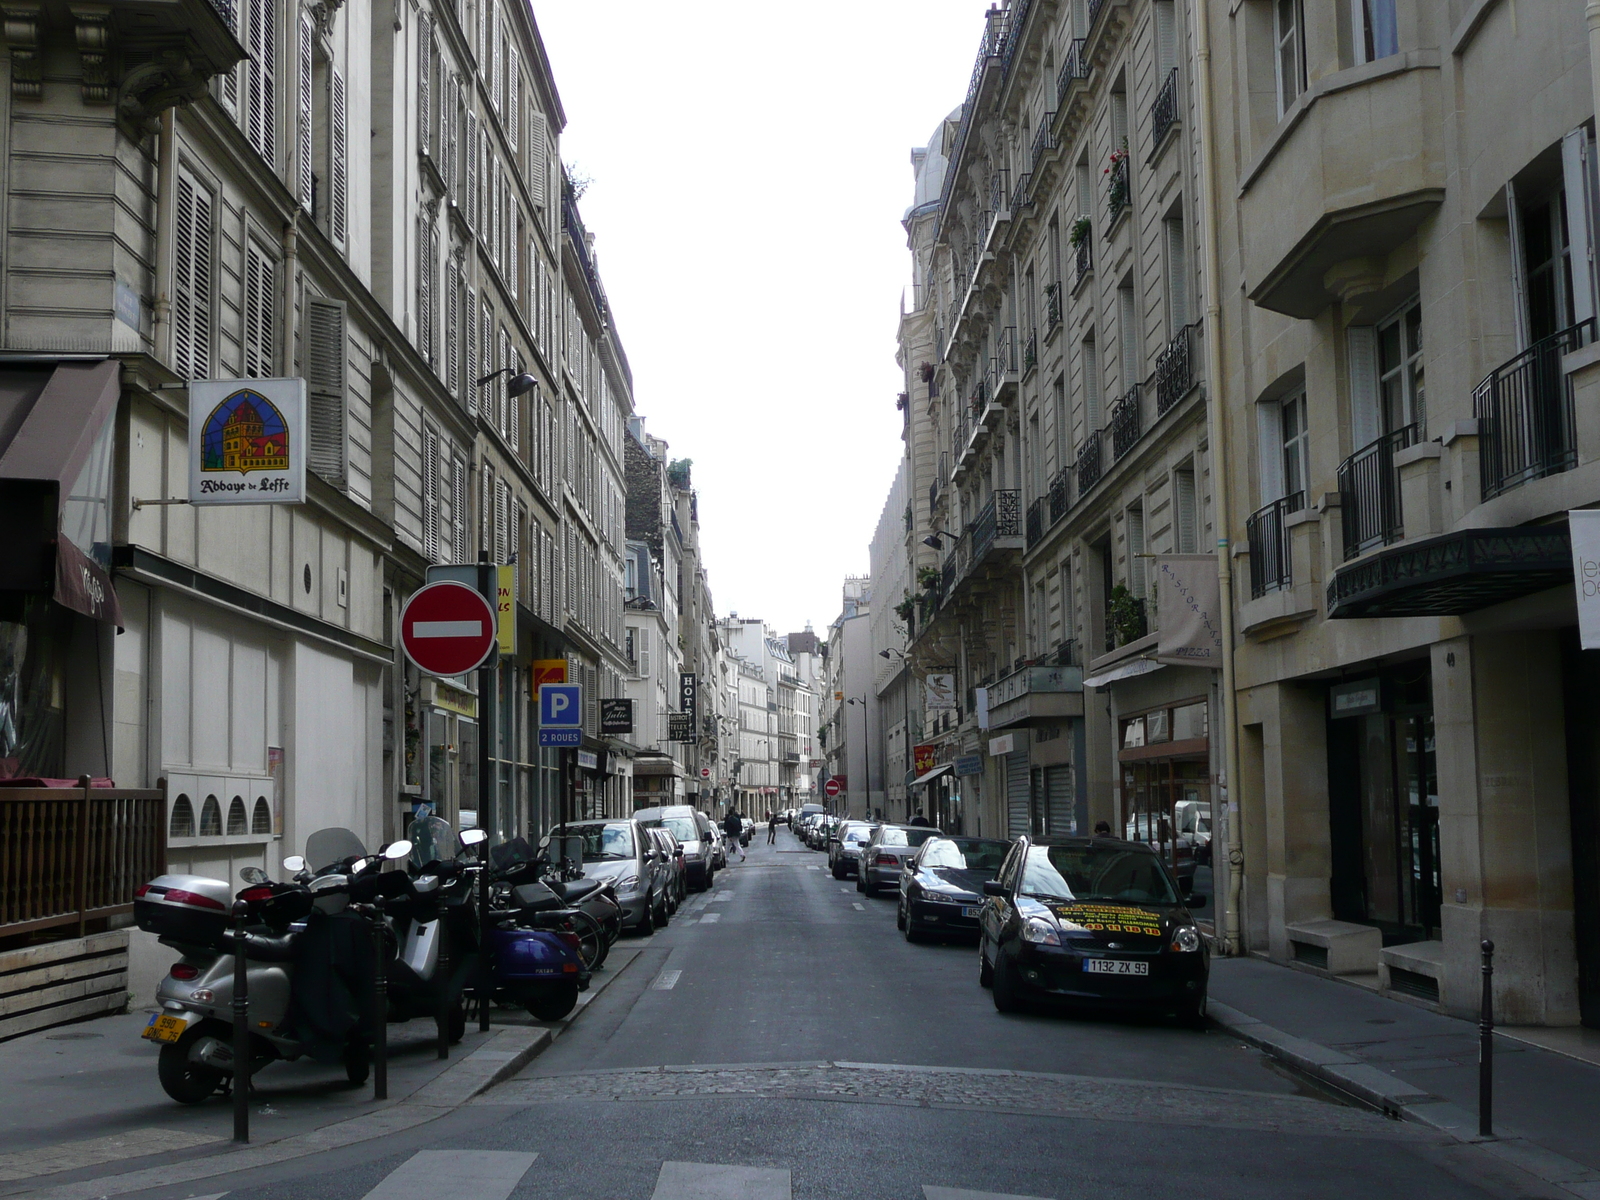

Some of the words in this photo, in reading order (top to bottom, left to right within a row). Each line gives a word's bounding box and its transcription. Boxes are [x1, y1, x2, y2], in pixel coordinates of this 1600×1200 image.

[200, 480, 245, 494] Abbaye
[259, 477, 290, 493] Leffe
[1161, 564, 1222, 647] RISTORANTE
[1176, 647, 1210, 657] PIZZA
[551, 693, 569, 718] P
[603, 710, 627, 721] Julie
[541, 734, 548, 742] 2
[551, 733, 579, 742] ROUES
[1091, 960, 1115, 972] 1132
[1118, 961, 1131, 973] ZX
[1134, 963, 1147, 974] 93
[159, 1018, 177, 1029] 990
[168, 1031, 179, 1041] 75
